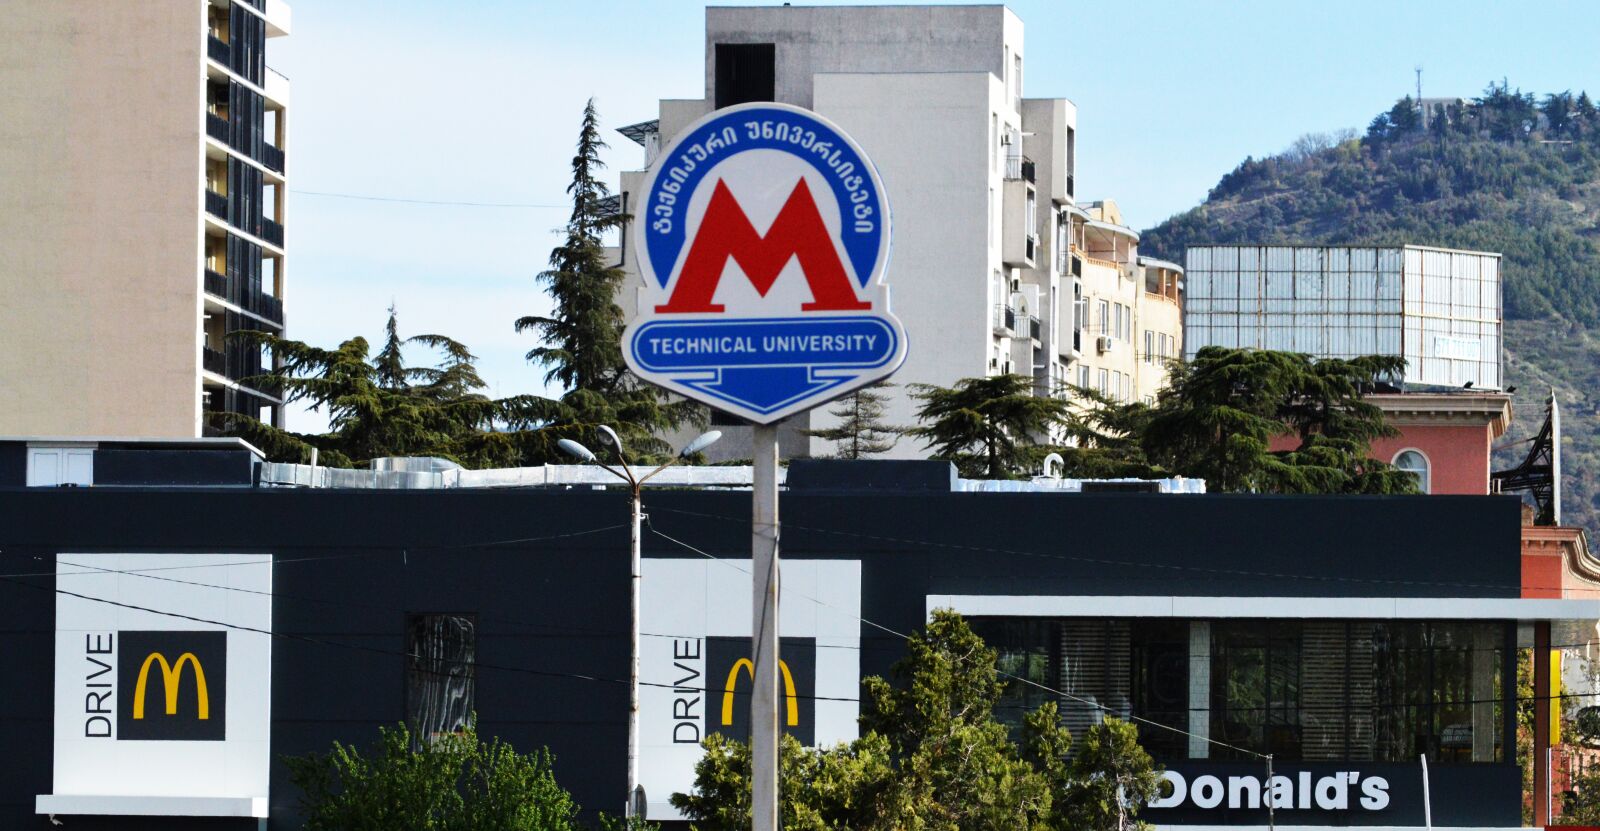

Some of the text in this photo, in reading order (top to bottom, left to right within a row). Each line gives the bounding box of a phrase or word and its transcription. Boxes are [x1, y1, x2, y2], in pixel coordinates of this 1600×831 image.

[653, 121, 874, 234] ტექნიკური უნივერსიტეტი
[650, 334, 877, 355] TECHNICAL UNIVERSITY
[85, 633, 113, 738] DRIVE
[673, 638, 701, 744] DRIVE
[1066, 769, 1390, 811] Donald's
